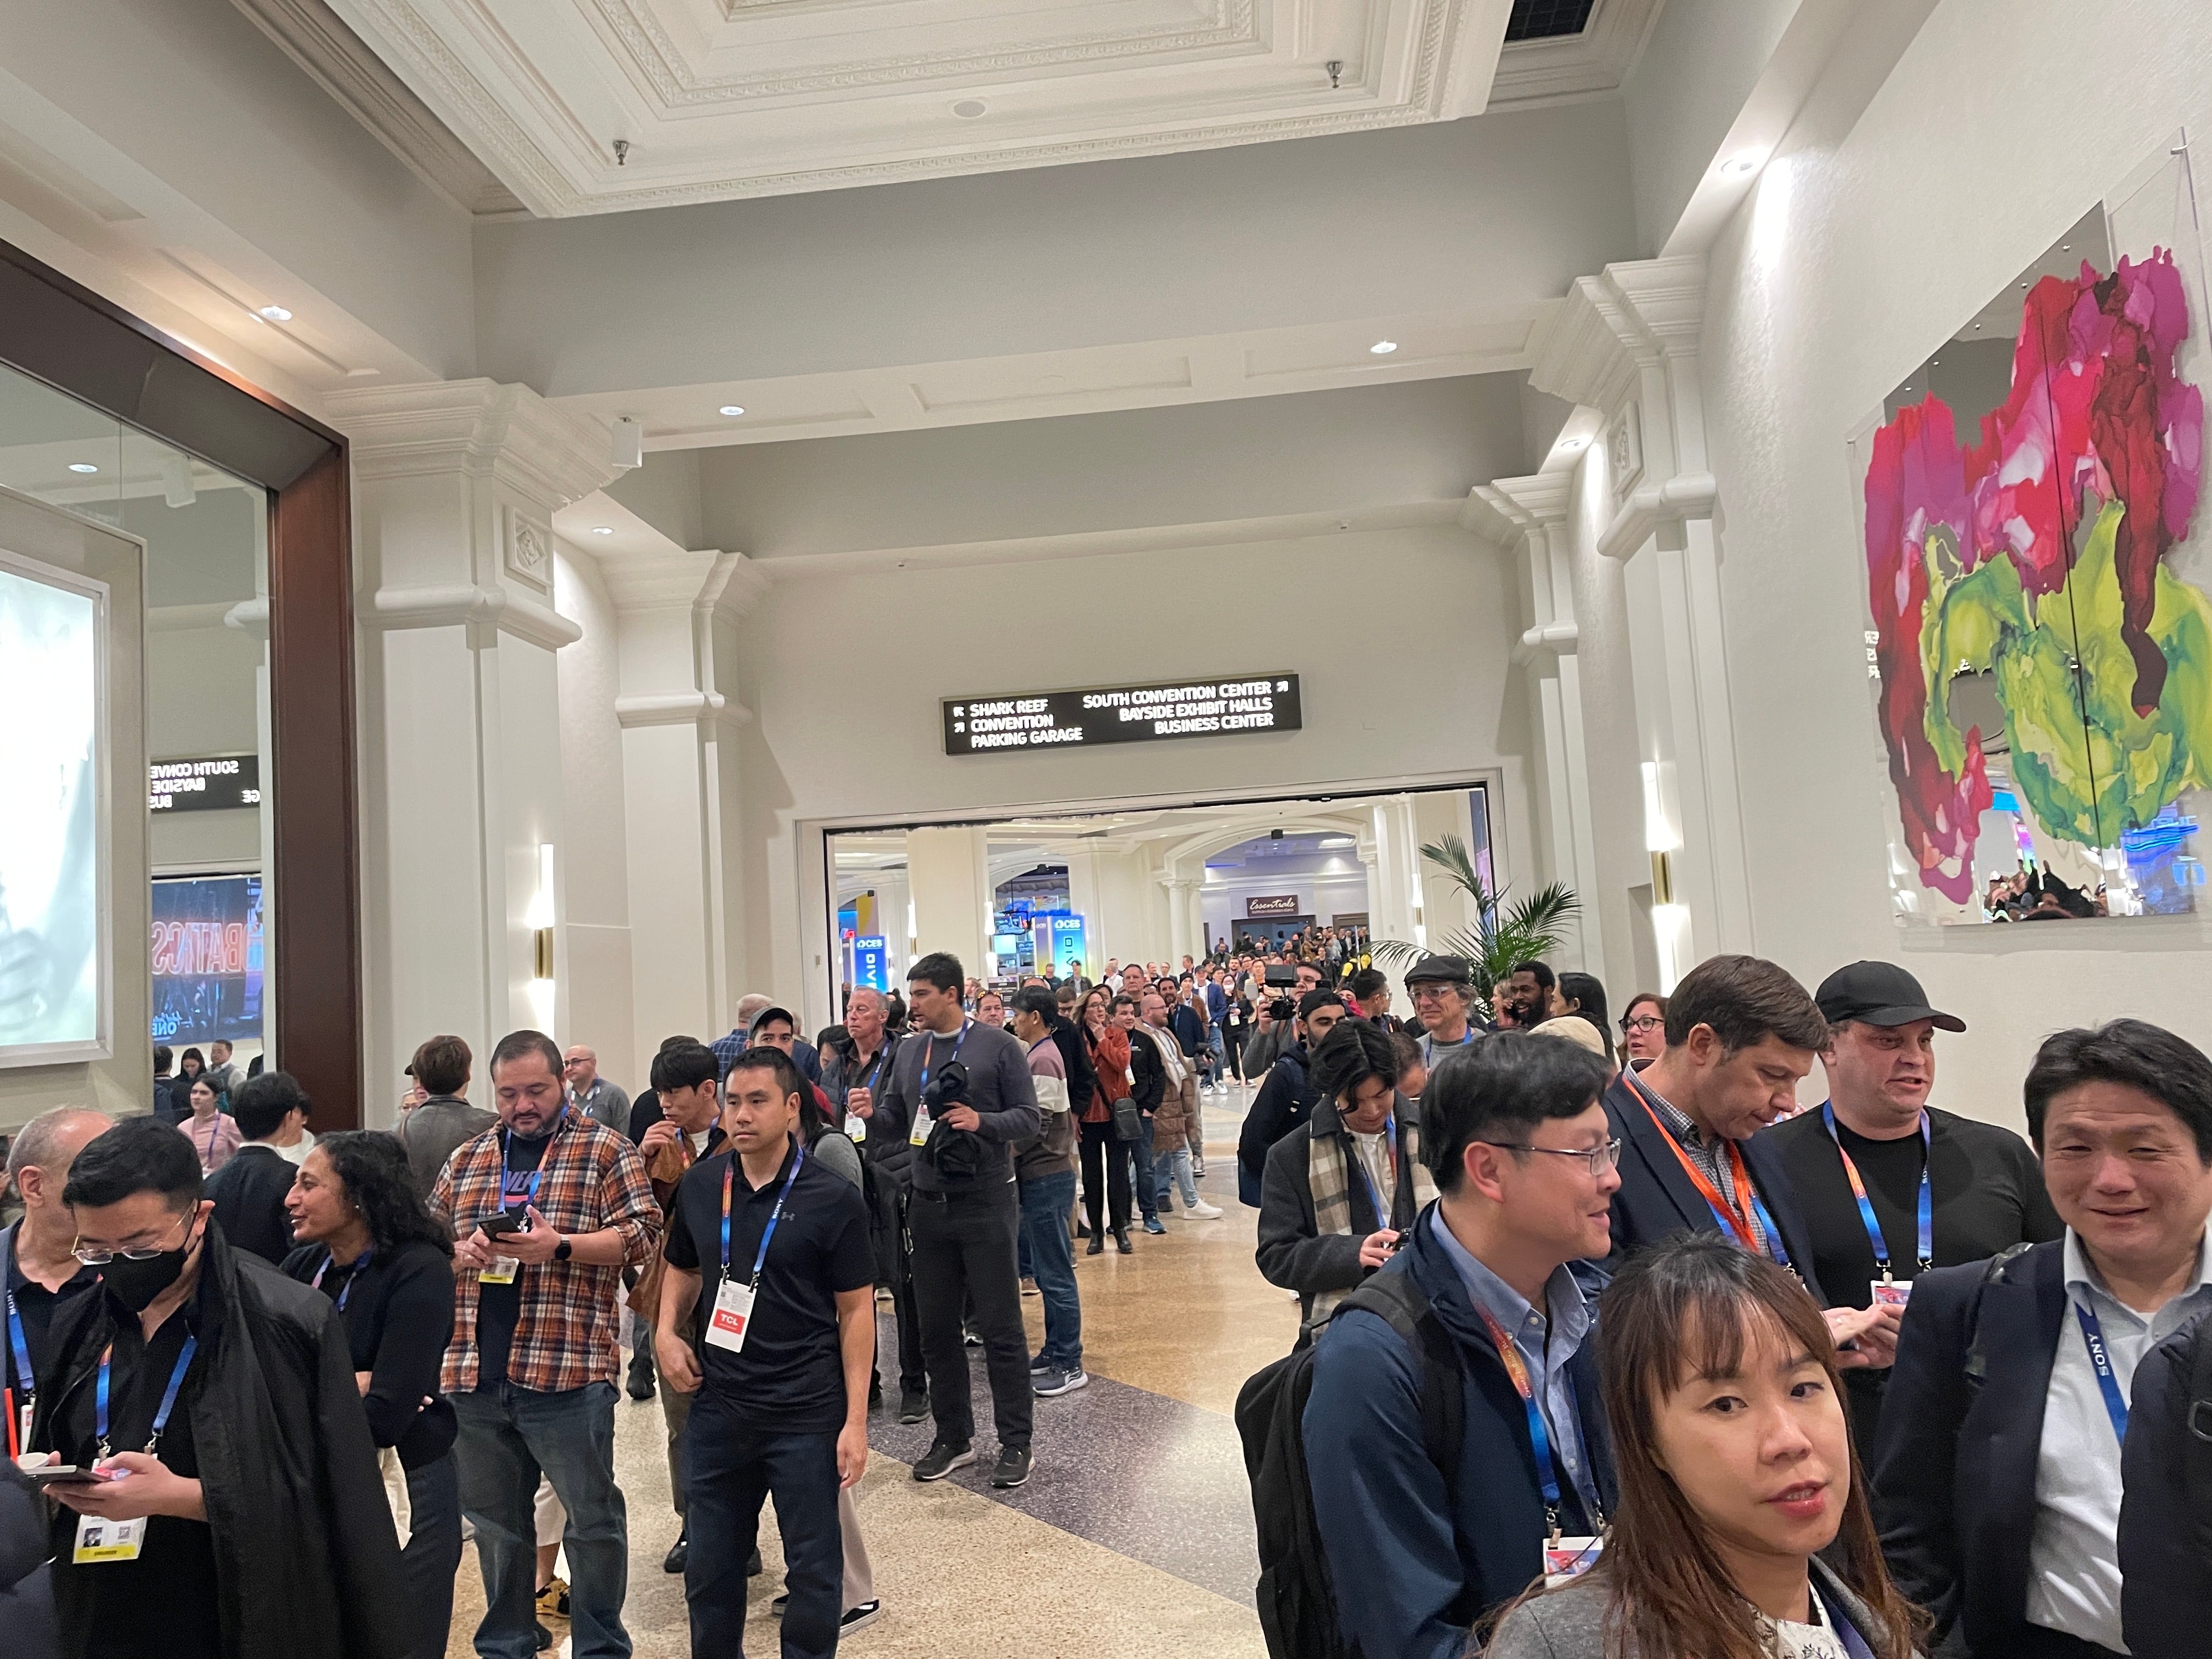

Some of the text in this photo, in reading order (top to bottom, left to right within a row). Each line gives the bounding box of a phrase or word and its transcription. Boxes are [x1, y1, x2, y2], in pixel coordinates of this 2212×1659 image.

[1083, 681, 1272, 708] SOUTH CONVENTION CENTER
[970, 699, 1049, 717] SHARK REEF
[1120, 697, 1273, 721] BAYSIDE EXHIBIT HALLS
[971, 714, 1054, 732] CONVENTION
[1155, 713, 1274, 735] BUSINESS CENTER
[971, 727, 1084, 748] PARKING GARAGE
[1250, 896, 1296, 910] Essentials
[1064, 919, 1081, 928] CES
[866, 939, 883, 947] CES
[772, 1198, 783, 1219] SONY
[720, 1313, 738, 1326] TCL
[2087, 1333, 2109, 1376] SONY
